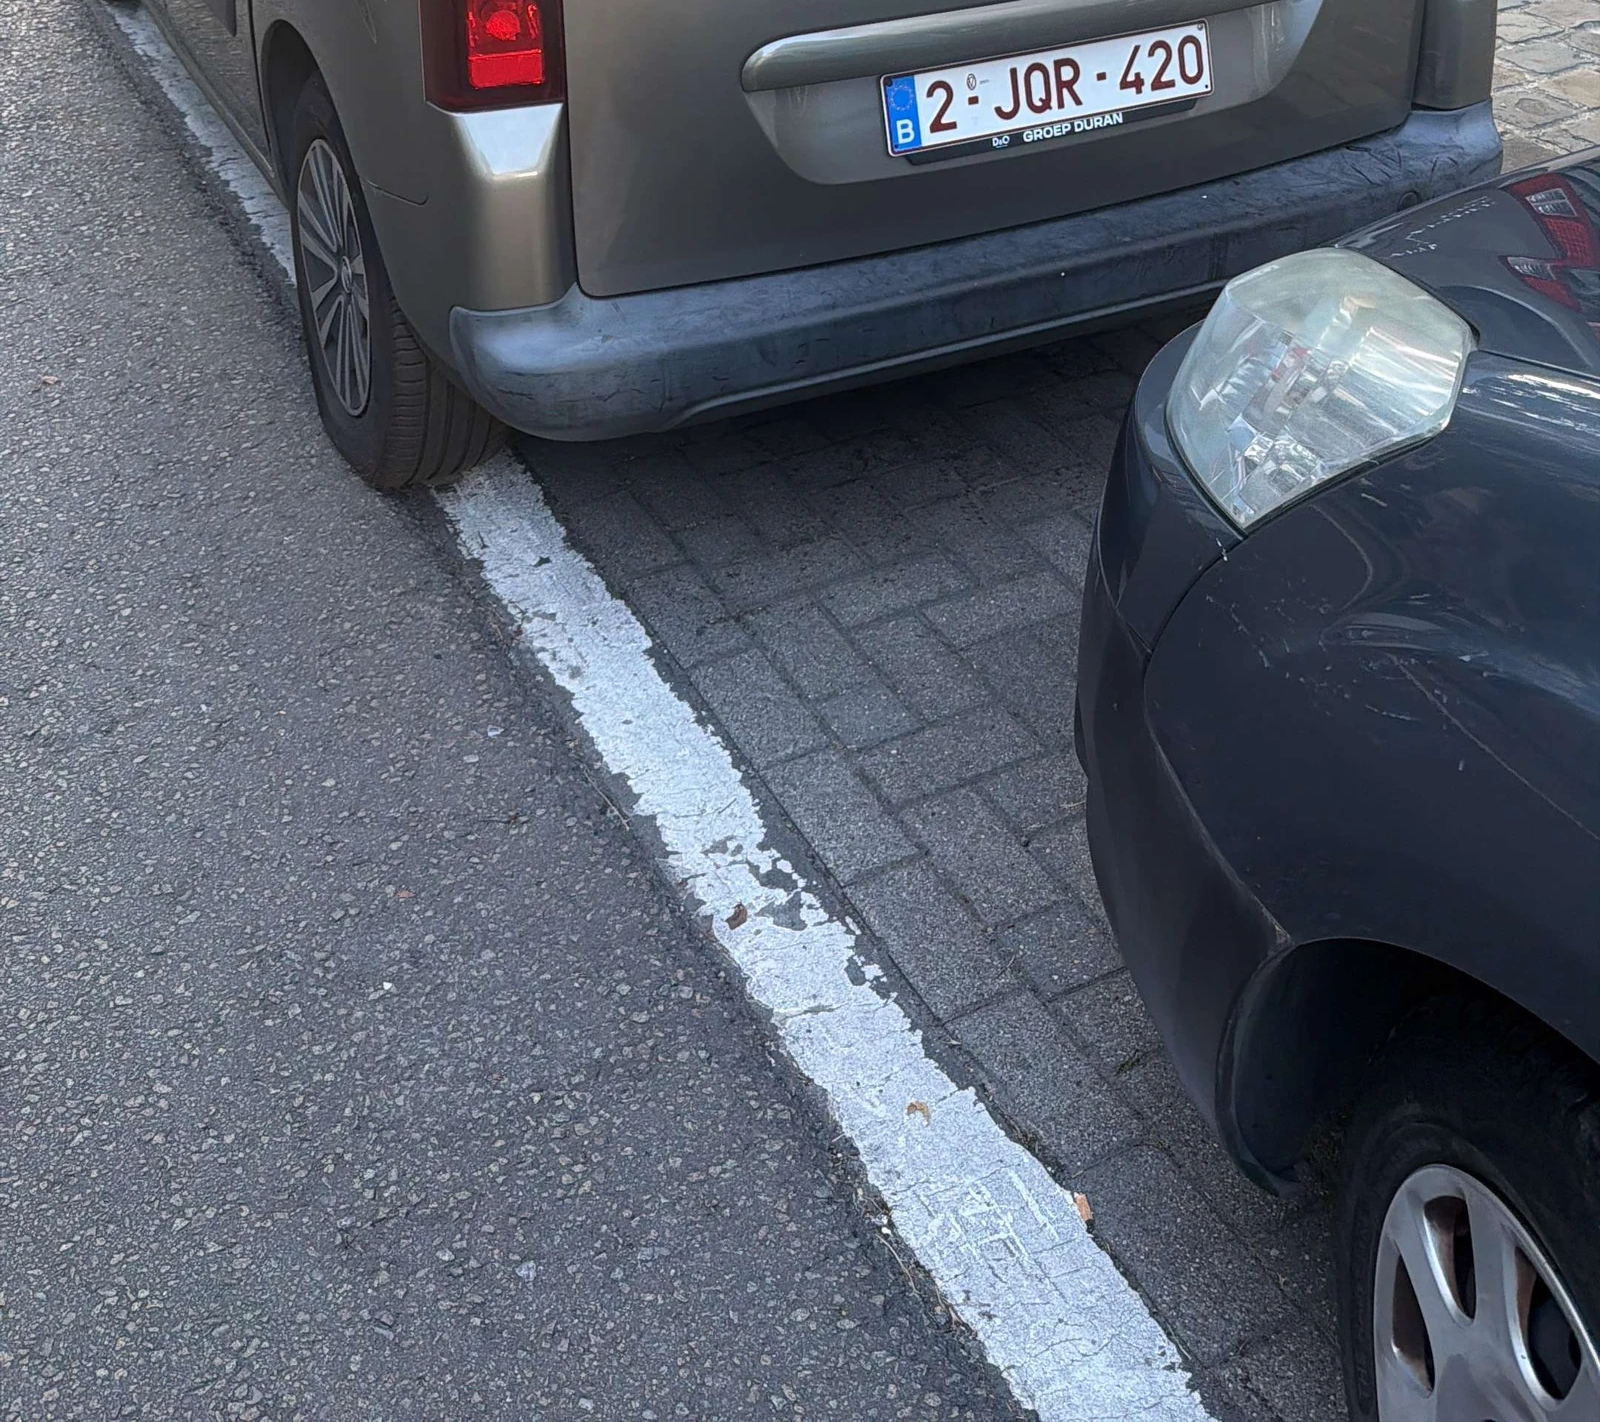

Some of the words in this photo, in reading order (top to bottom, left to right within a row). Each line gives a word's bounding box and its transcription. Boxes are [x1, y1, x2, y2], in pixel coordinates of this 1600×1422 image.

[896, 119, 915, 144] B
[1022, 122, 1072, 143] GROEP
[1074, 112, 1124, 133] DURAN
